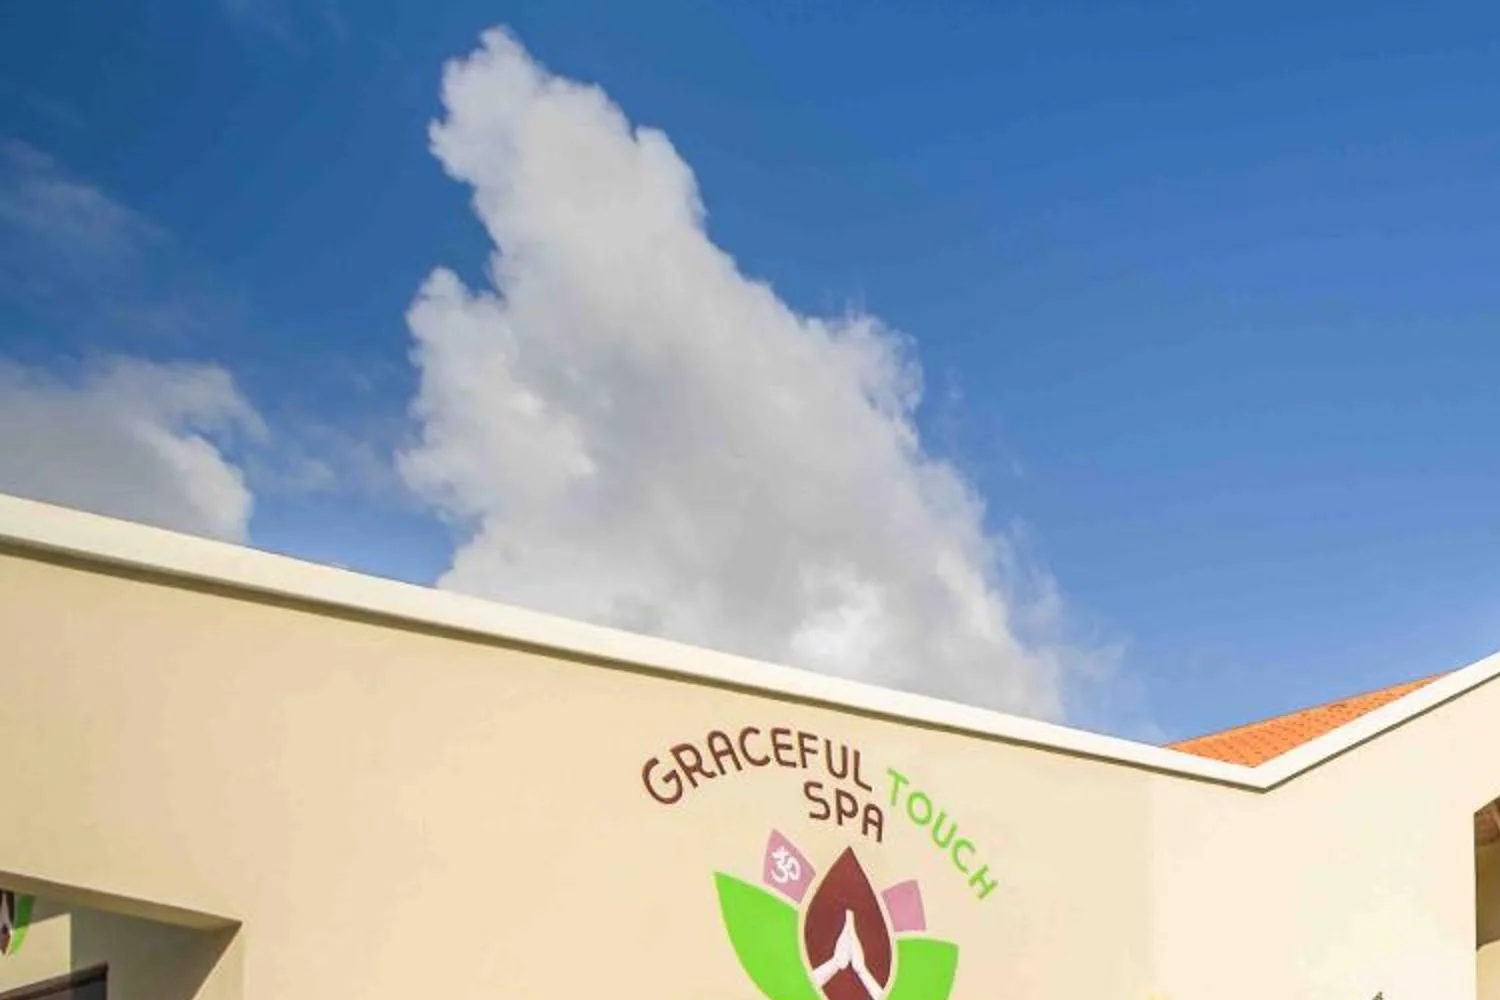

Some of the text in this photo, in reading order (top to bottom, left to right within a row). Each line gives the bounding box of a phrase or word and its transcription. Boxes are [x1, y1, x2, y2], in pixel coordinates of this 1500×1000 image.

[641, 726, 998, 900] GRACEFUL TOUCH
[804, 780, 884, 843] SPA
